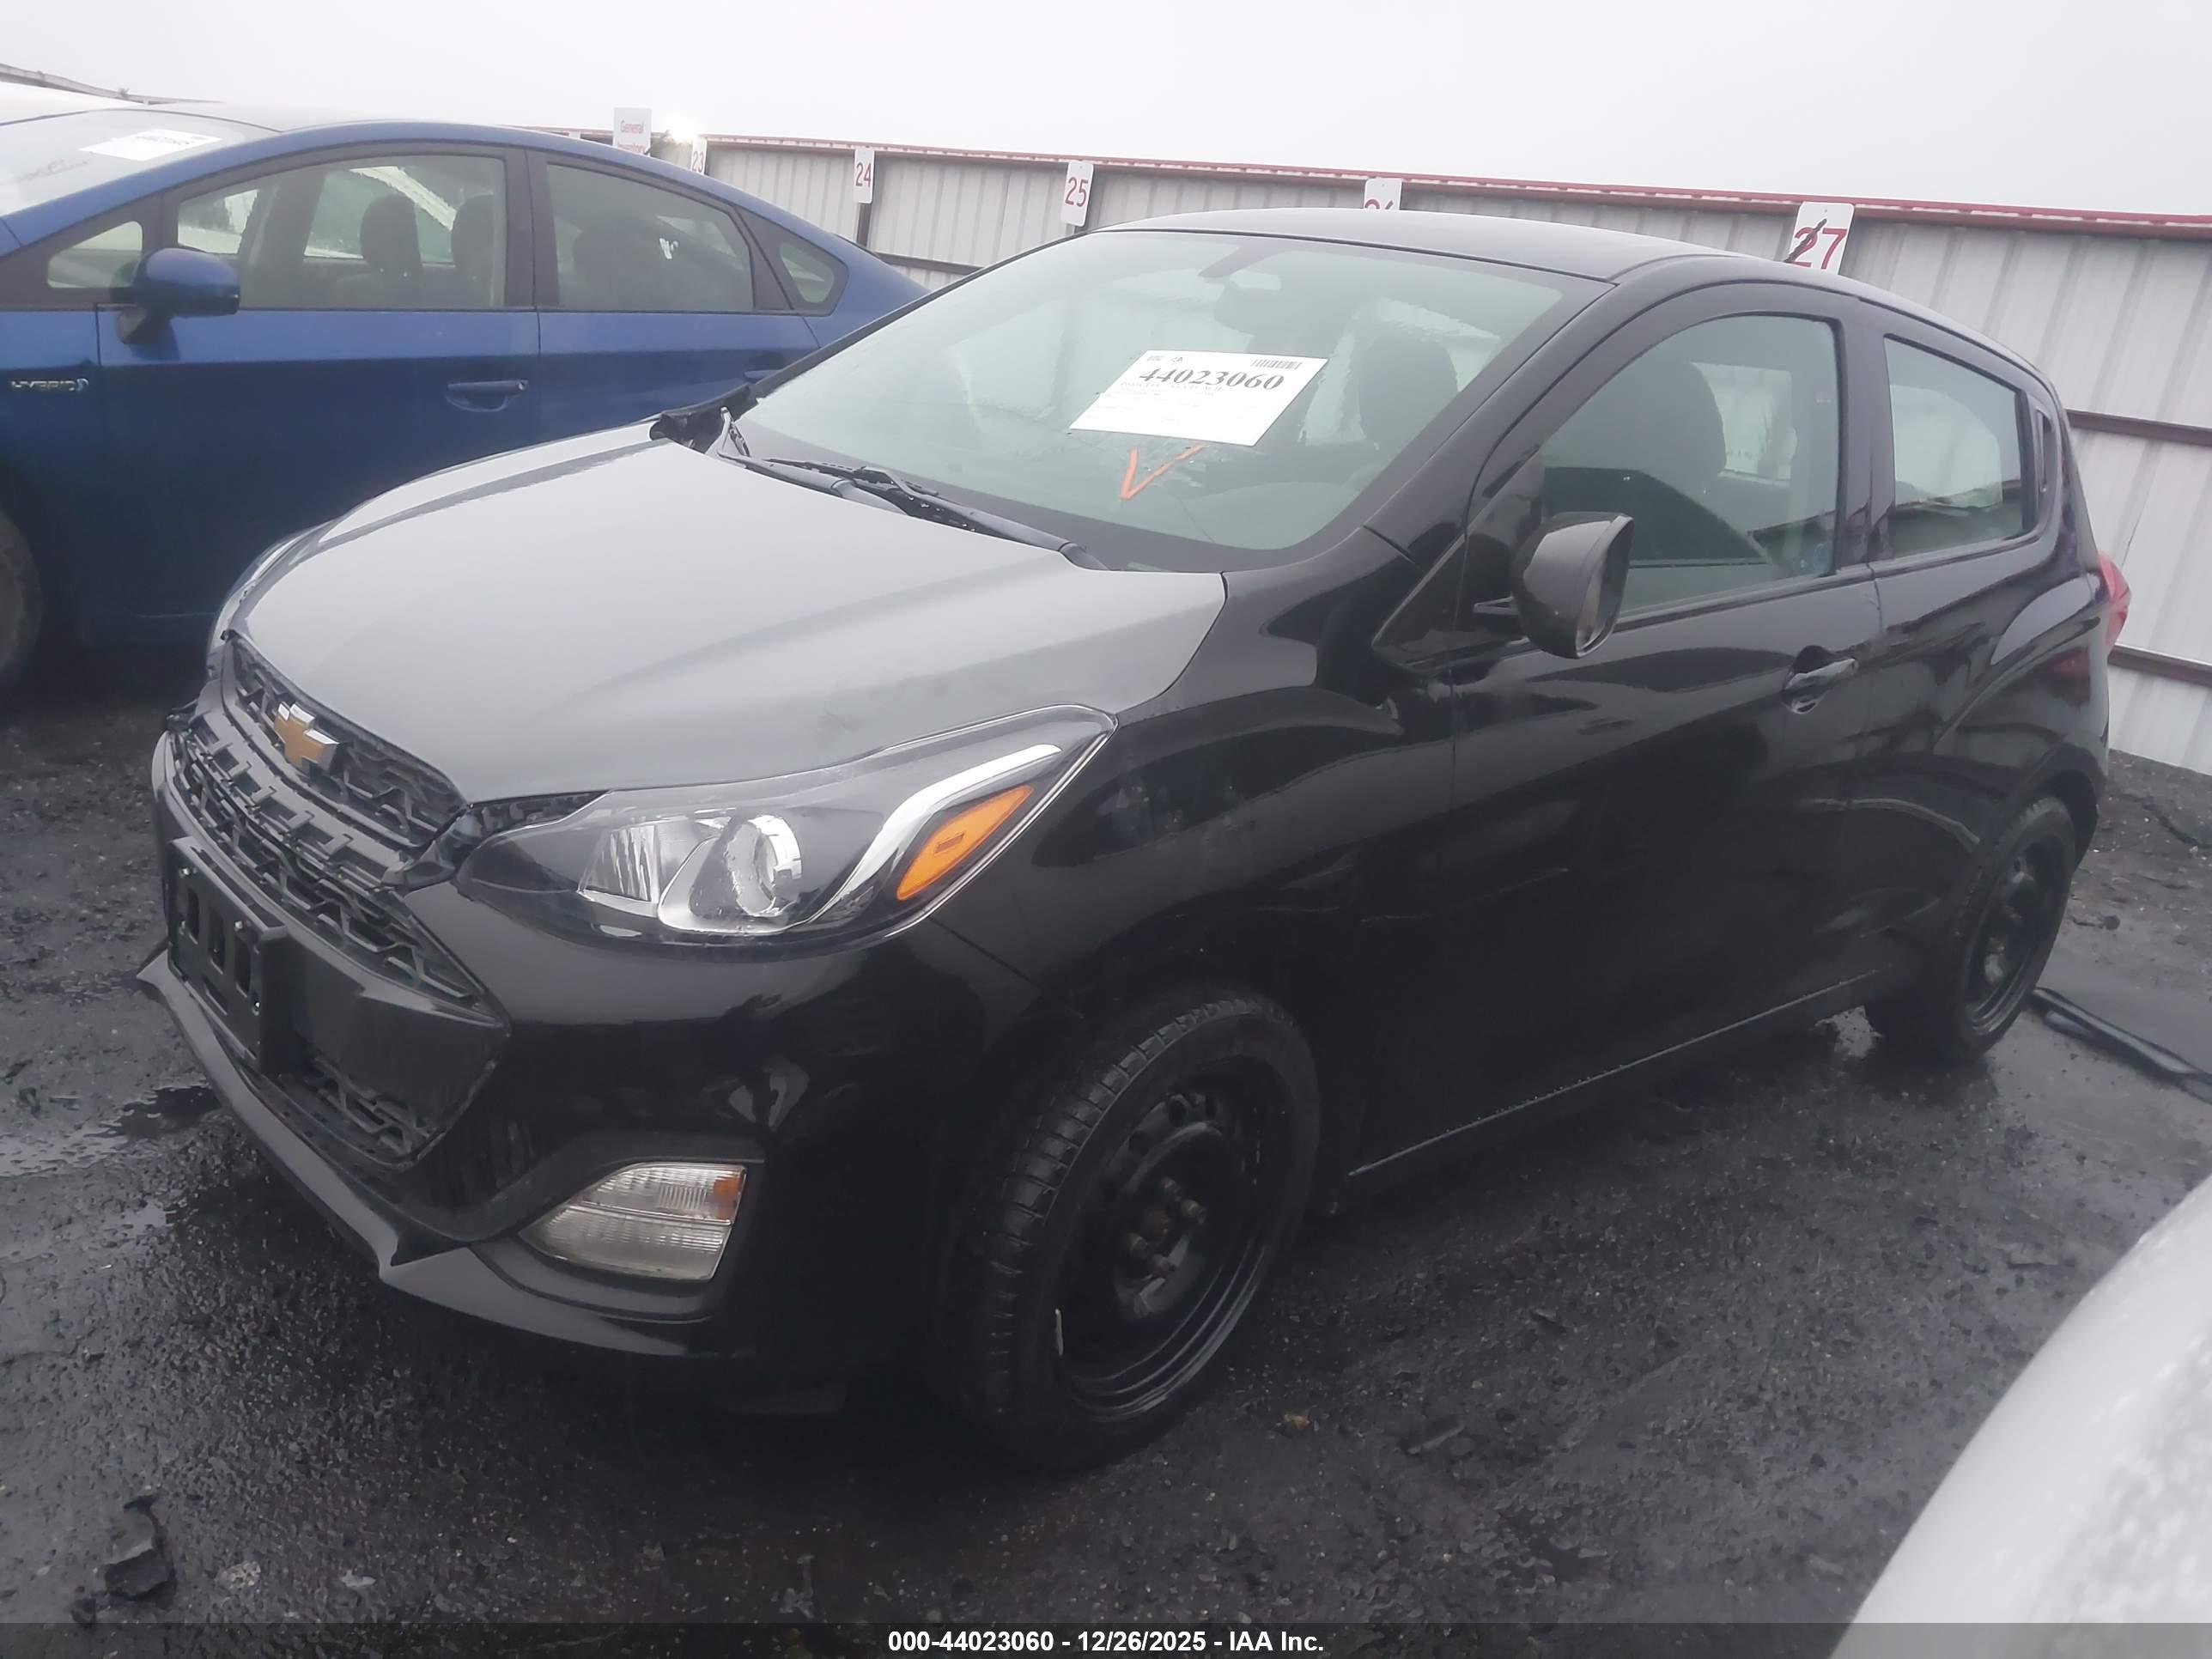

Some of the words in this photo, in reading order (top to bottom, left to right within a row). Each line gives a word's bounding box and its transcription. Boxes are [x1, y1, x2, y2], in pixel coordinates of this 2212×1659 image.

[692, 150, 704, 173] 23
[855, 161, 872, 187] 24
[1065, 176, 1089, 207] 25
[1789, 227, 1848, 270] 27
[1139, 368, 1285, 391] 44023060
